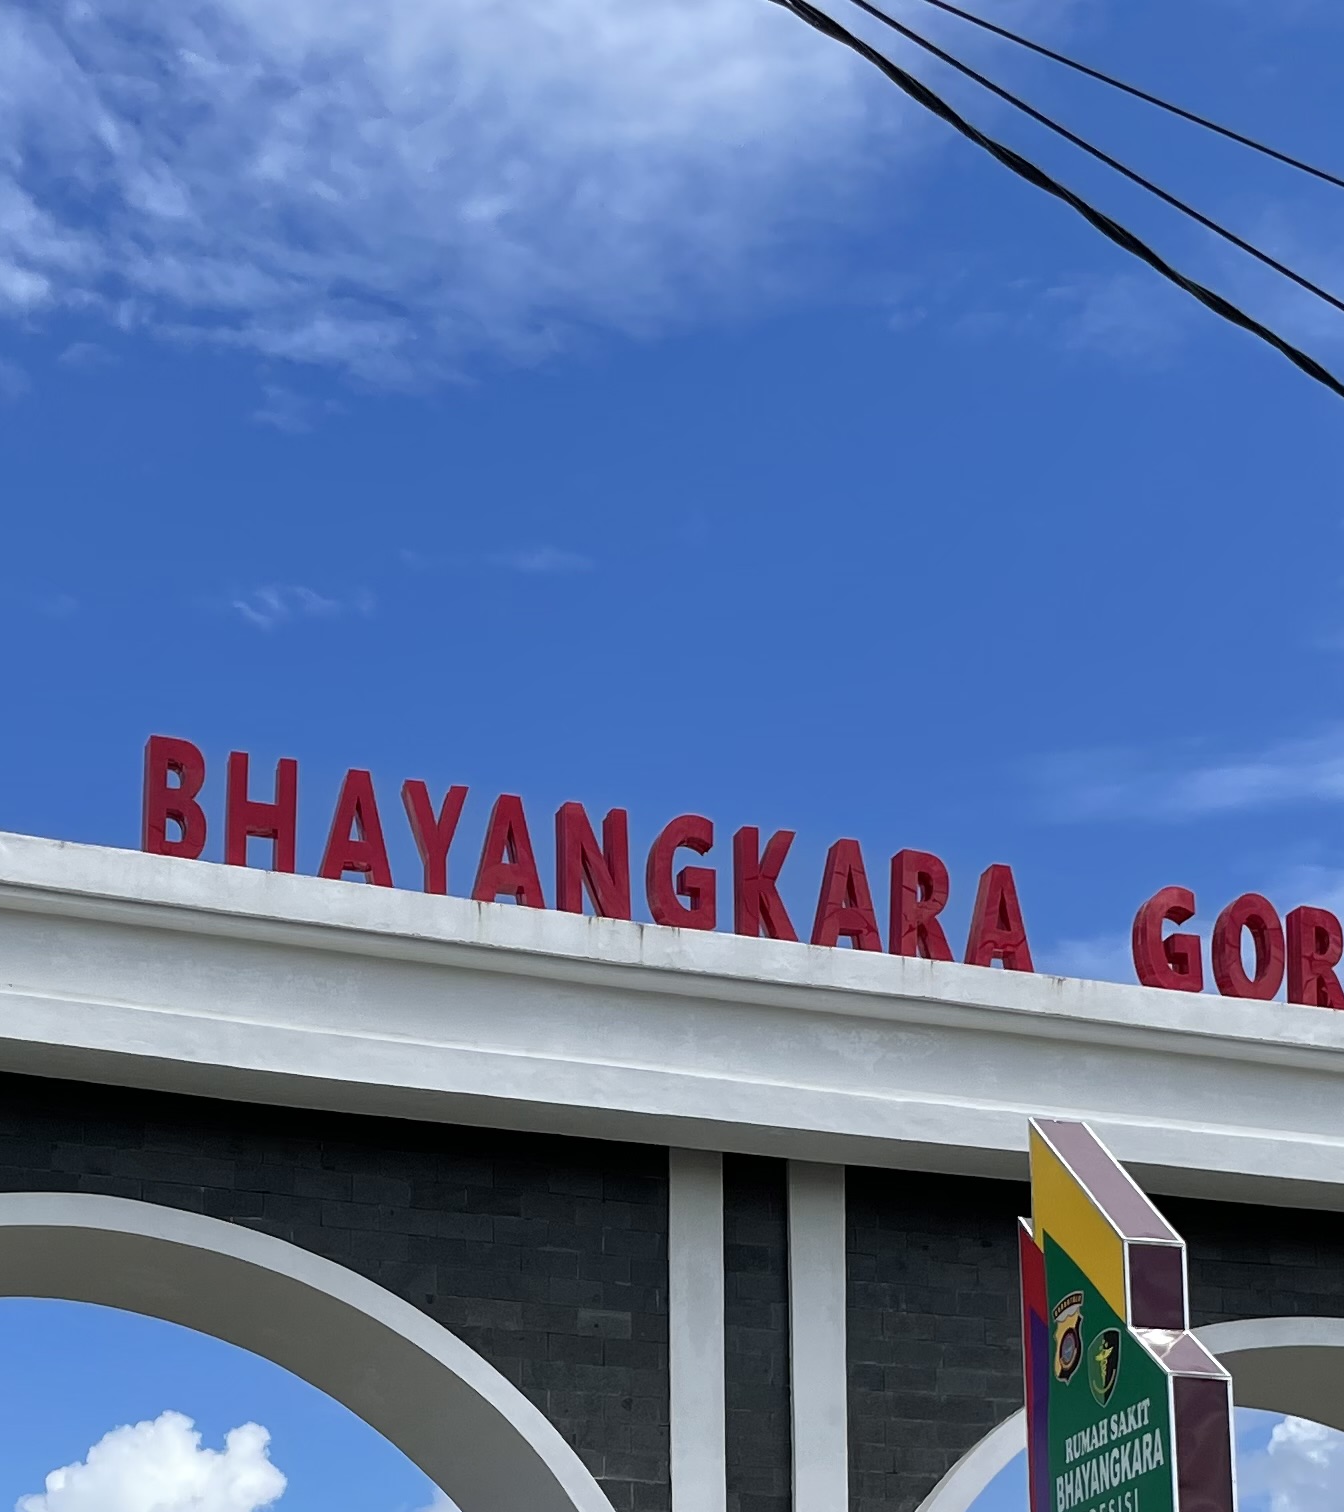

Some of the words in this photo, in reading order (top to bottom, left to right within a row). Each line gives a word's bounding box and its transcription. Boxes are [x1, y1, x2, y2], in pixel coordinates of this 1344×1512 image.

[143, 734, 1035, 973] BHAYANGKARA
[1065, 1419, 1108, 1464] RUMAH
[1110, 1398, 1150, 1441] SAKIT
